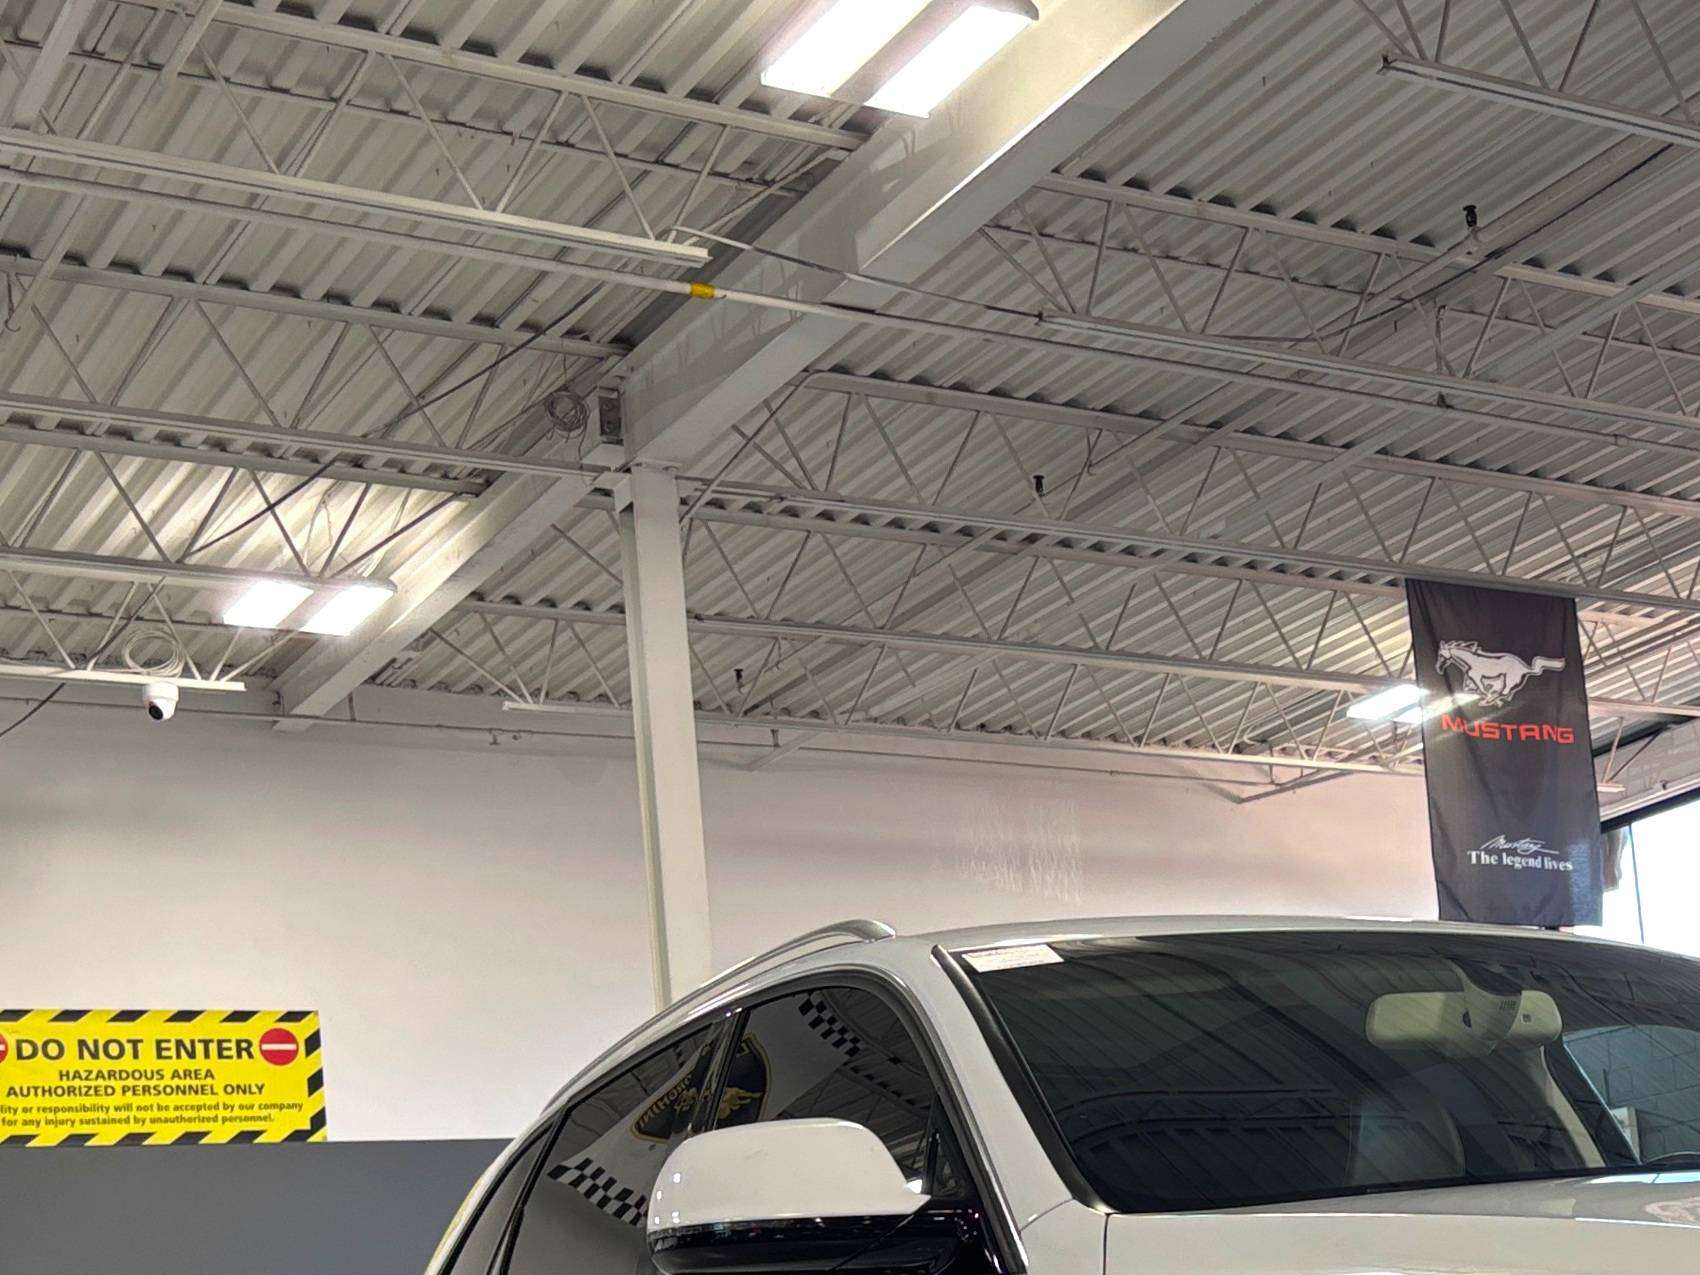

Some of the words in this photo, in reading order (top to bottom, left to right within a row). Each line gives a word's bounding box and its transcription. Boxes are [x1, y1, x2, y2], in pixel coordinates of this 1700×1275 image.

[1442, 714, 1575, 744] MUSTANG
[1467, 850, 1498, 865] The
[1502, 852, 1541, 870] legend
[1544, 856, 1573, 871] lives
[15, 1038, 65, 1061] DO
[78, 1038, 144, 1061] NOT
[155, 1038, 254, 1060] ENTER
[58, 1069, 164, 1081] HAZARDOUS
[170, 1068, 215, 1080] AREA
[6, 1085, 116, 1098] AUTHORIZED
[121, 1084, 218, 1097] PERSONNEL
[223, 1083, 265, 1095] ONLY
[22, 1106, 33, 1114] or
[37, 1103, 110, 1115] responsibility
[114, 1103, 132, 1112] will
[136, 1103, 153, 1112] not
[157, 1102, 169, 1111] be
[173, 1102, 219, 1113] accepted
[223, 1102, 235, 1113] by
[238, 1103, 255, 1111] our
[258, 1102, 303, 1112] company
[2, 1117, 17, 1127] for
[21, 1119, 41, 1128] any
[45, 1117, 76, 1128] injury
[80, 1116, 130, 1125] sustained
[133, 1115, 147, 1127] by
[149, 1115, 218, 1124] unauthorized
